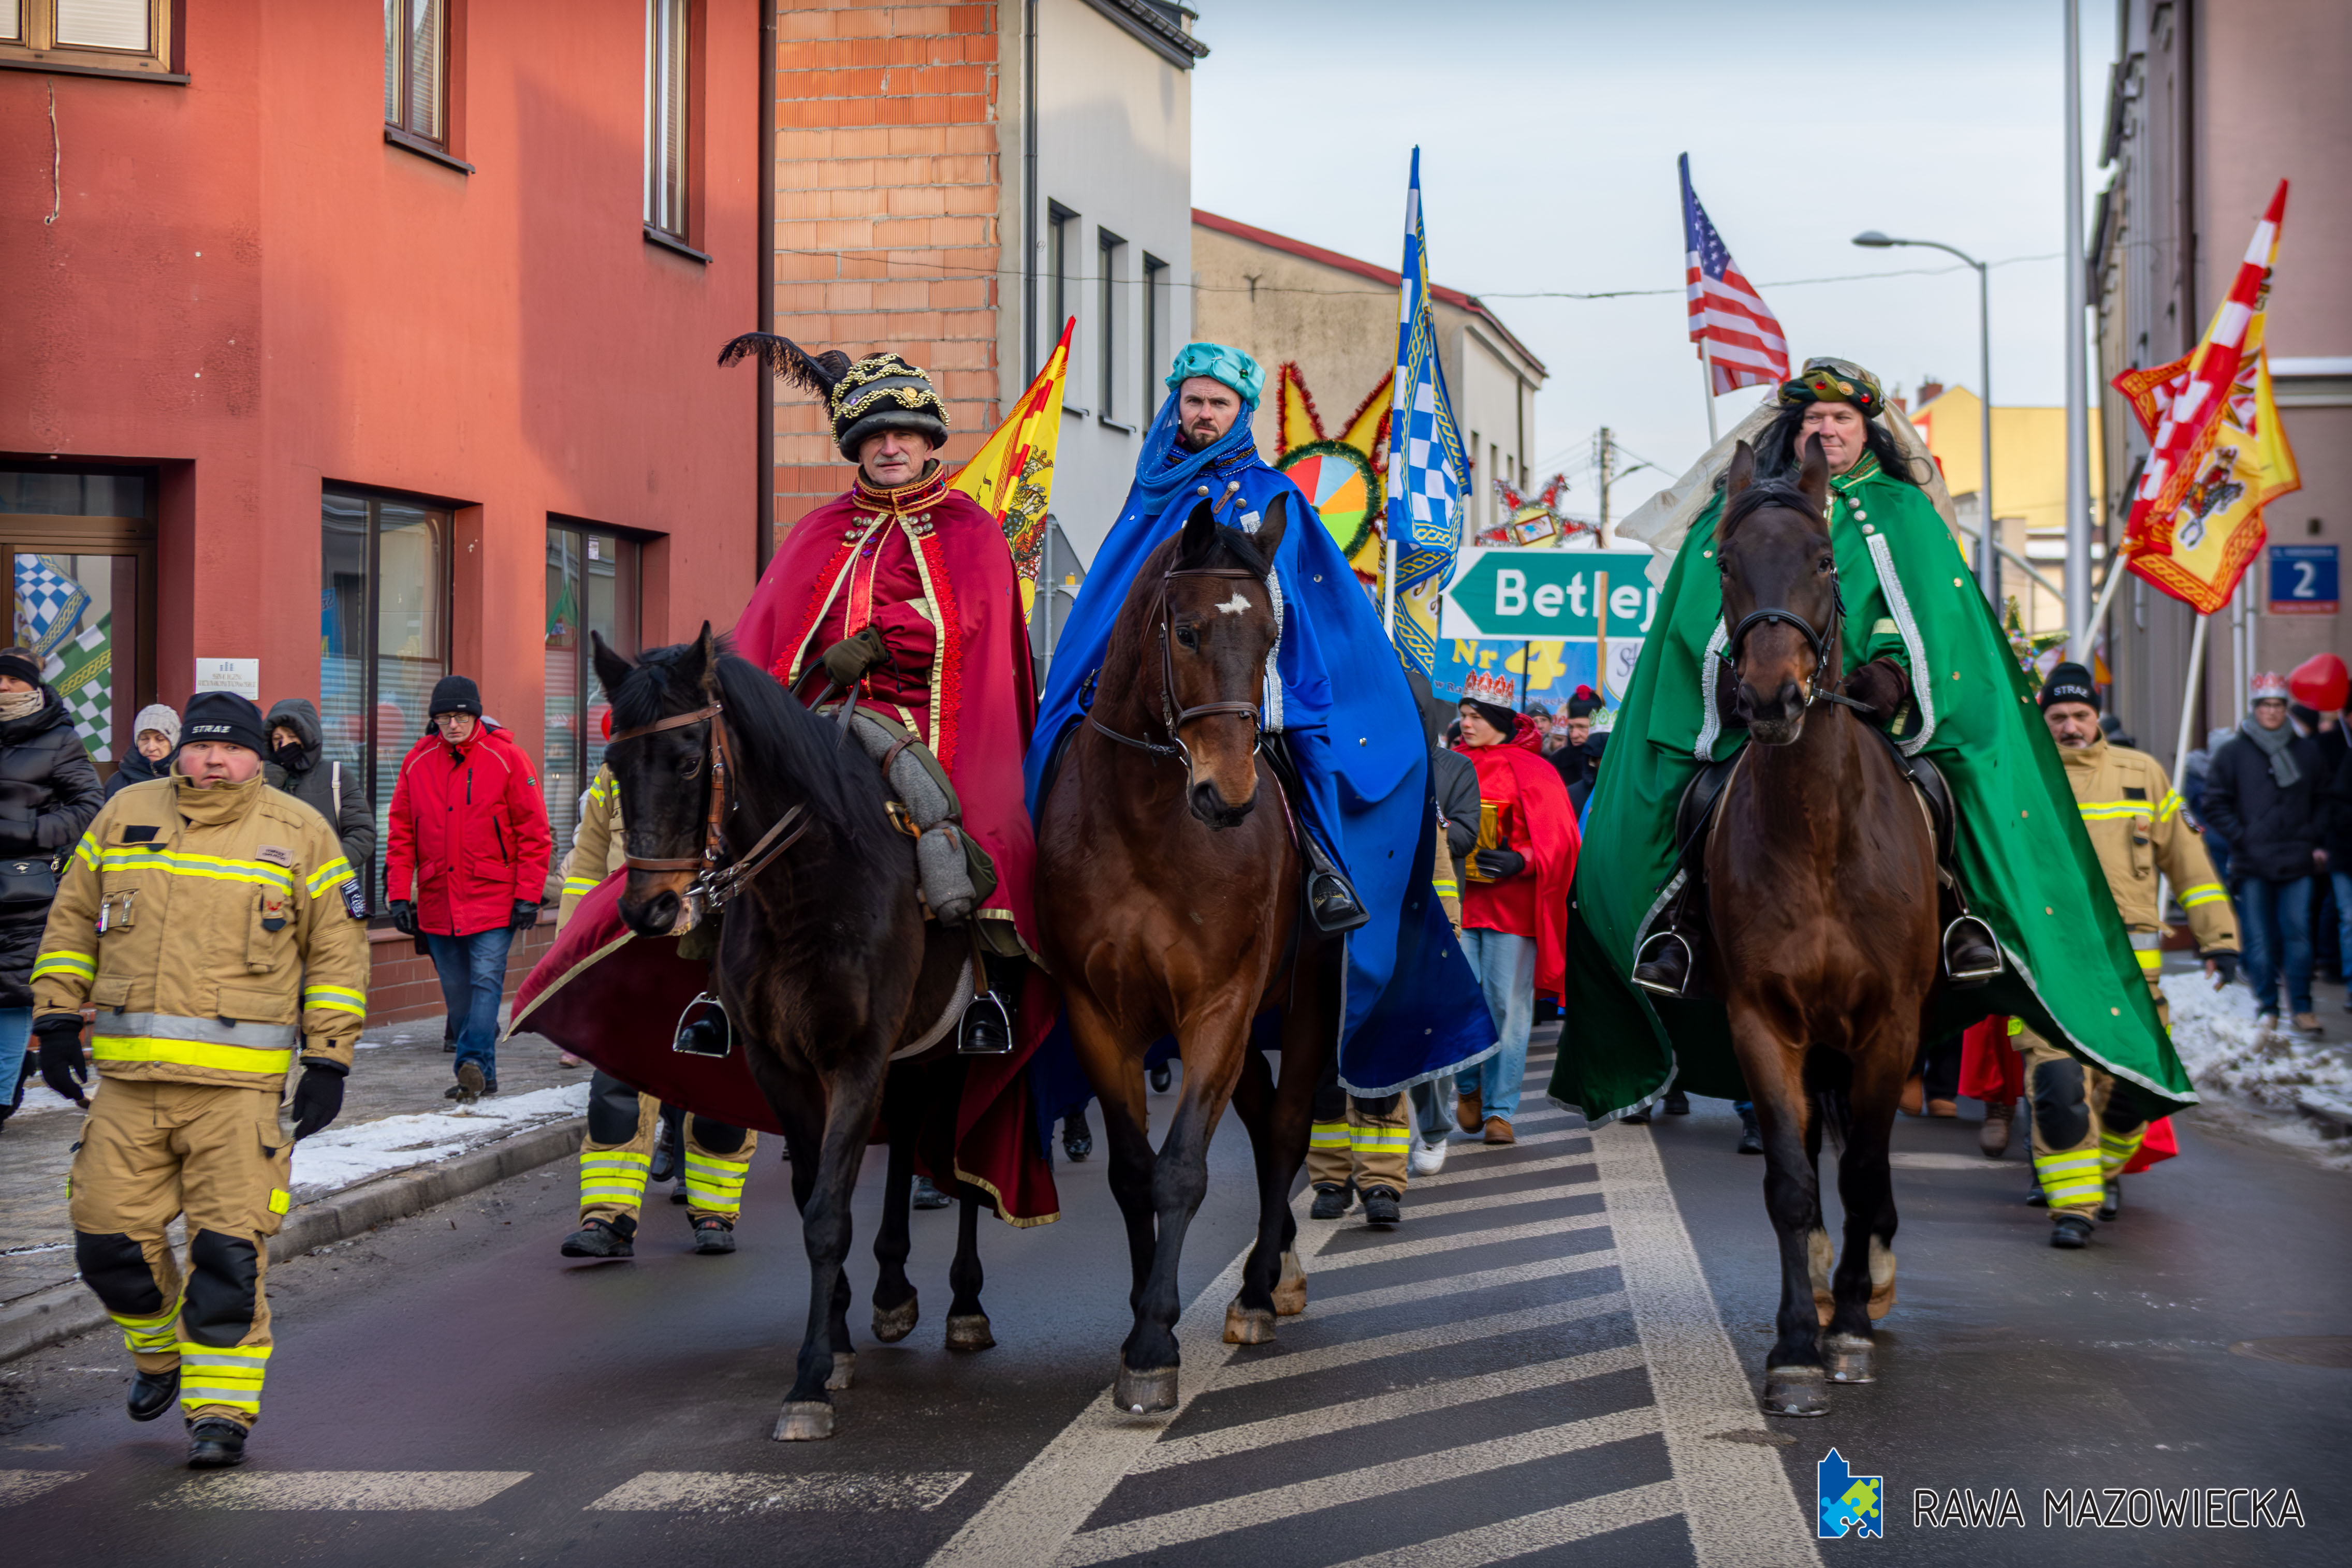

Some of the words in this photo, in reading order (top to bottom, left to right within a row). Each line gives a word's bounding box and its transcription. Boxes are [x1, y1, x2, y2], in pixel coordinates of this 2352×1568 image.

[1495, 568, 1656, 633] Betlej
[2293, 561, 2316, 597] 2
[1452, 639, 1498, 669] Nr
[1504, 641, 1567, 690] 4
